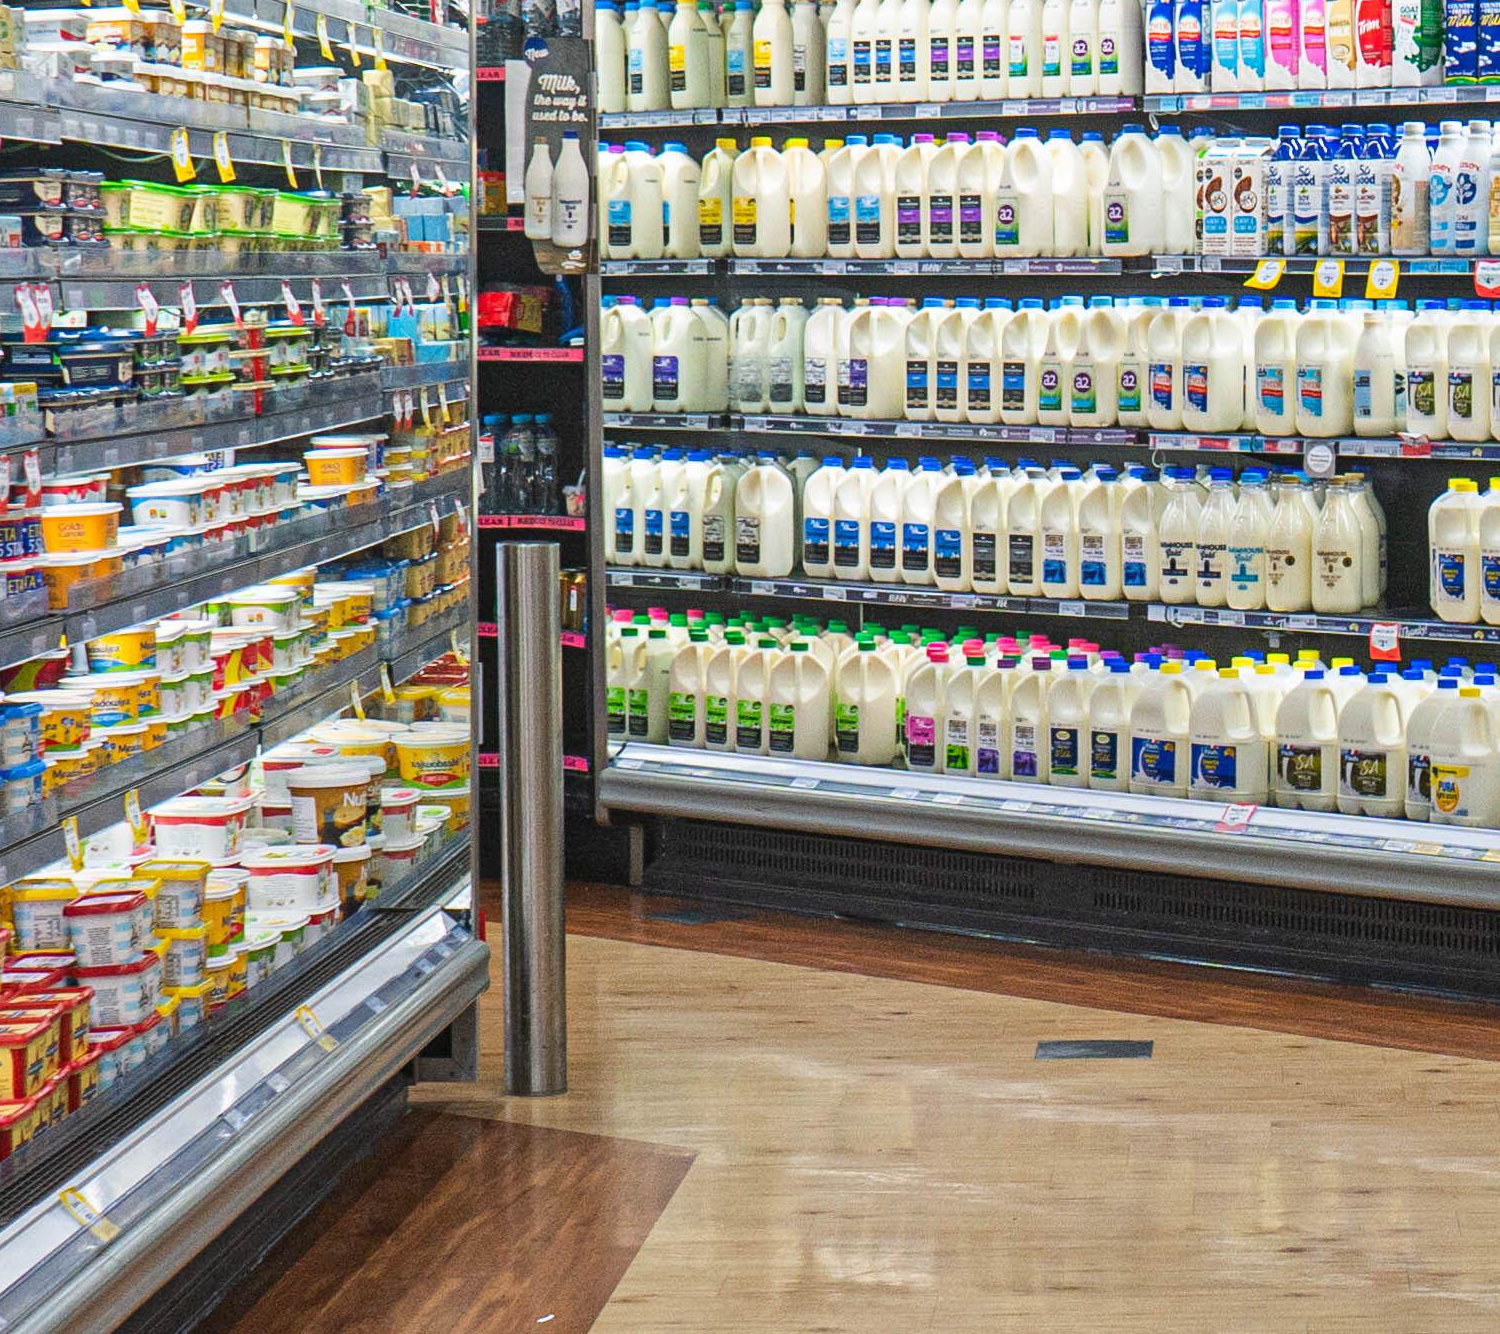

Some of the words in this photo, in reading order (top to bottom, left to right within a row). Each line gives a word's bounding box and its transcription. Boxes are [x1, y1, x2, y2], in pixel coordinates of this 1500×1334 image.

[1400, 5, 1419, 13] GOAT
[1447, 14, 1475, 28] Milk
[1358, 19, 1381, 36] Trim
[1072, 42, 1088, 55] a2
[1102, 41, 1116, 53] a2
[537, 73, 581, 95] Milk,
[534, 94, 551, 106] the
[553, 95, 577, 110] way
[578, 94, 587, 106] it
[532, 110, 557, 122] used
[558, 111, 569, 122] to
[1298, 165, 1309, 177] So
[1332, 165, 1345, 176] So
[1359, 164, 1371, 176] So
[999, 208, 1014, 220] a2
[1108, 207, 1124, 219] a2
[1043, 373, 1058, 385] a2
[4, 542, 24, 558] STA
[1436, 781, 1456, 793] PURA
